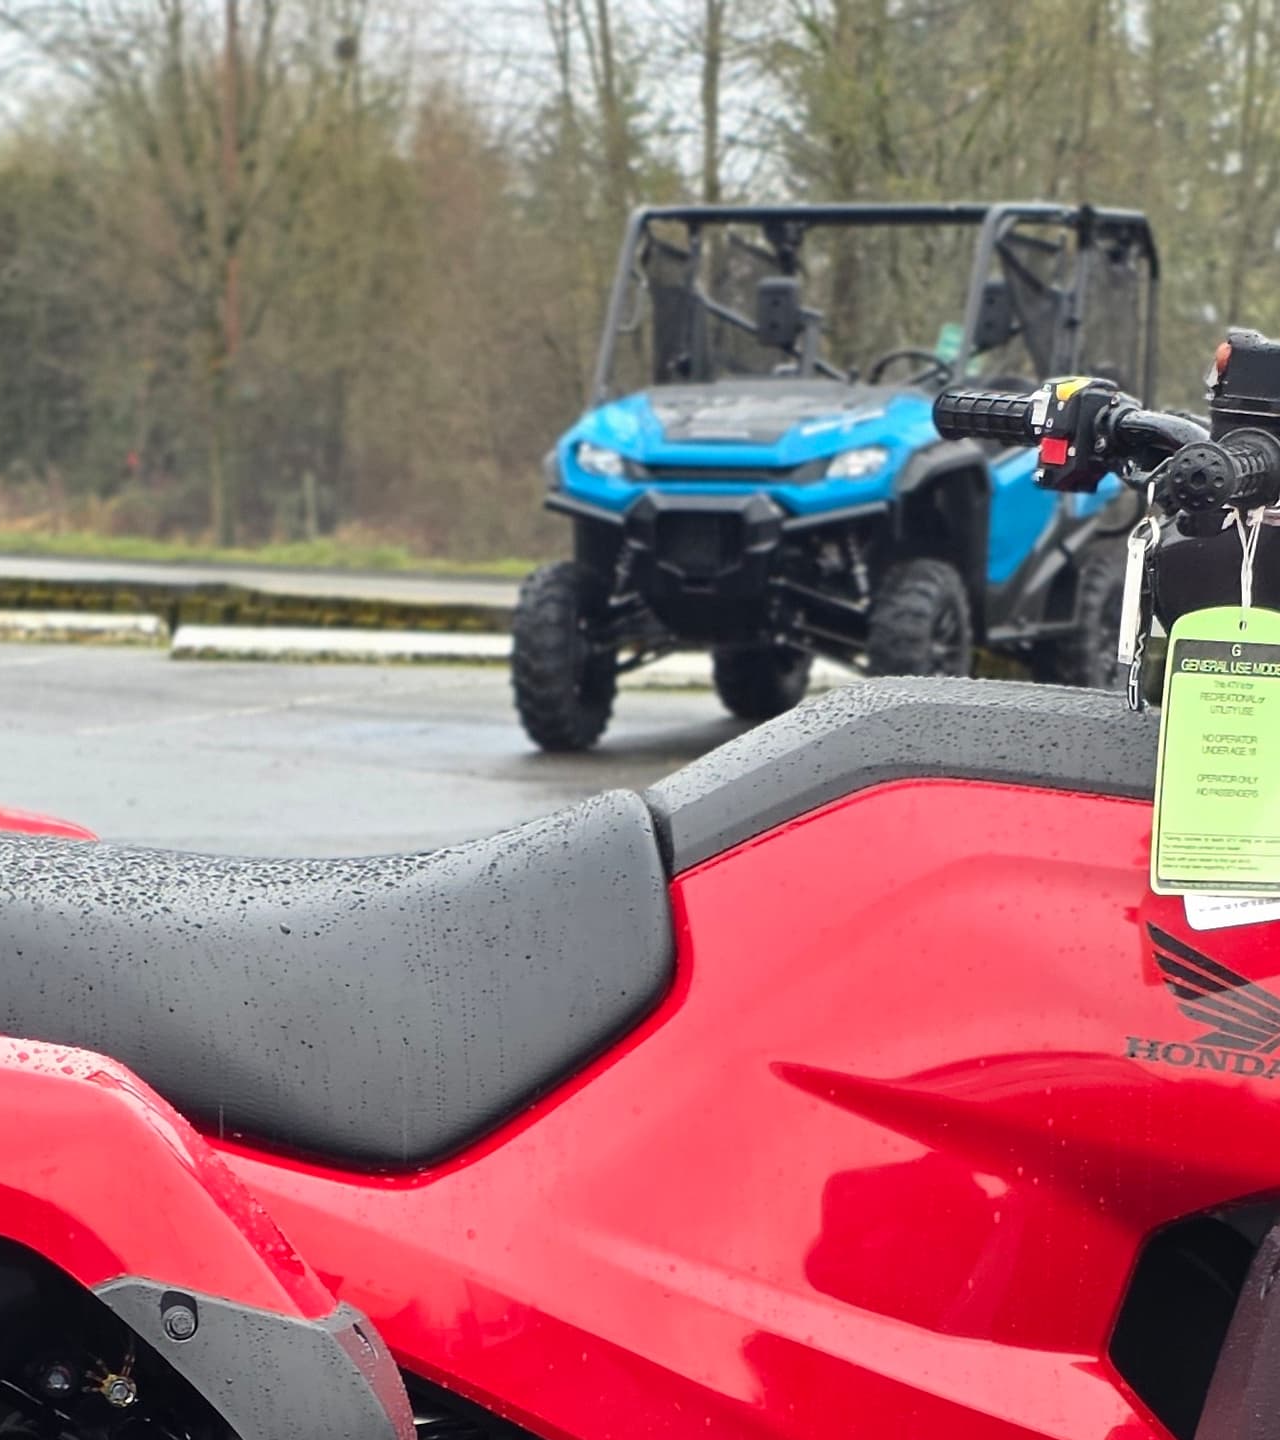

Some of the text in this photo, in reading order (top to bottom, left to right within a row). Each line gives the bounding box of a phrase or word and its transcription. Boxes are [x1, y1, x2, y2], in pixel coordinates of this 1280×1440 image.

[1231, 643, 1242, 657] G
[1181, 658, 1229, 673] GENERAL
[1230, 661, 1252, 674] USE
